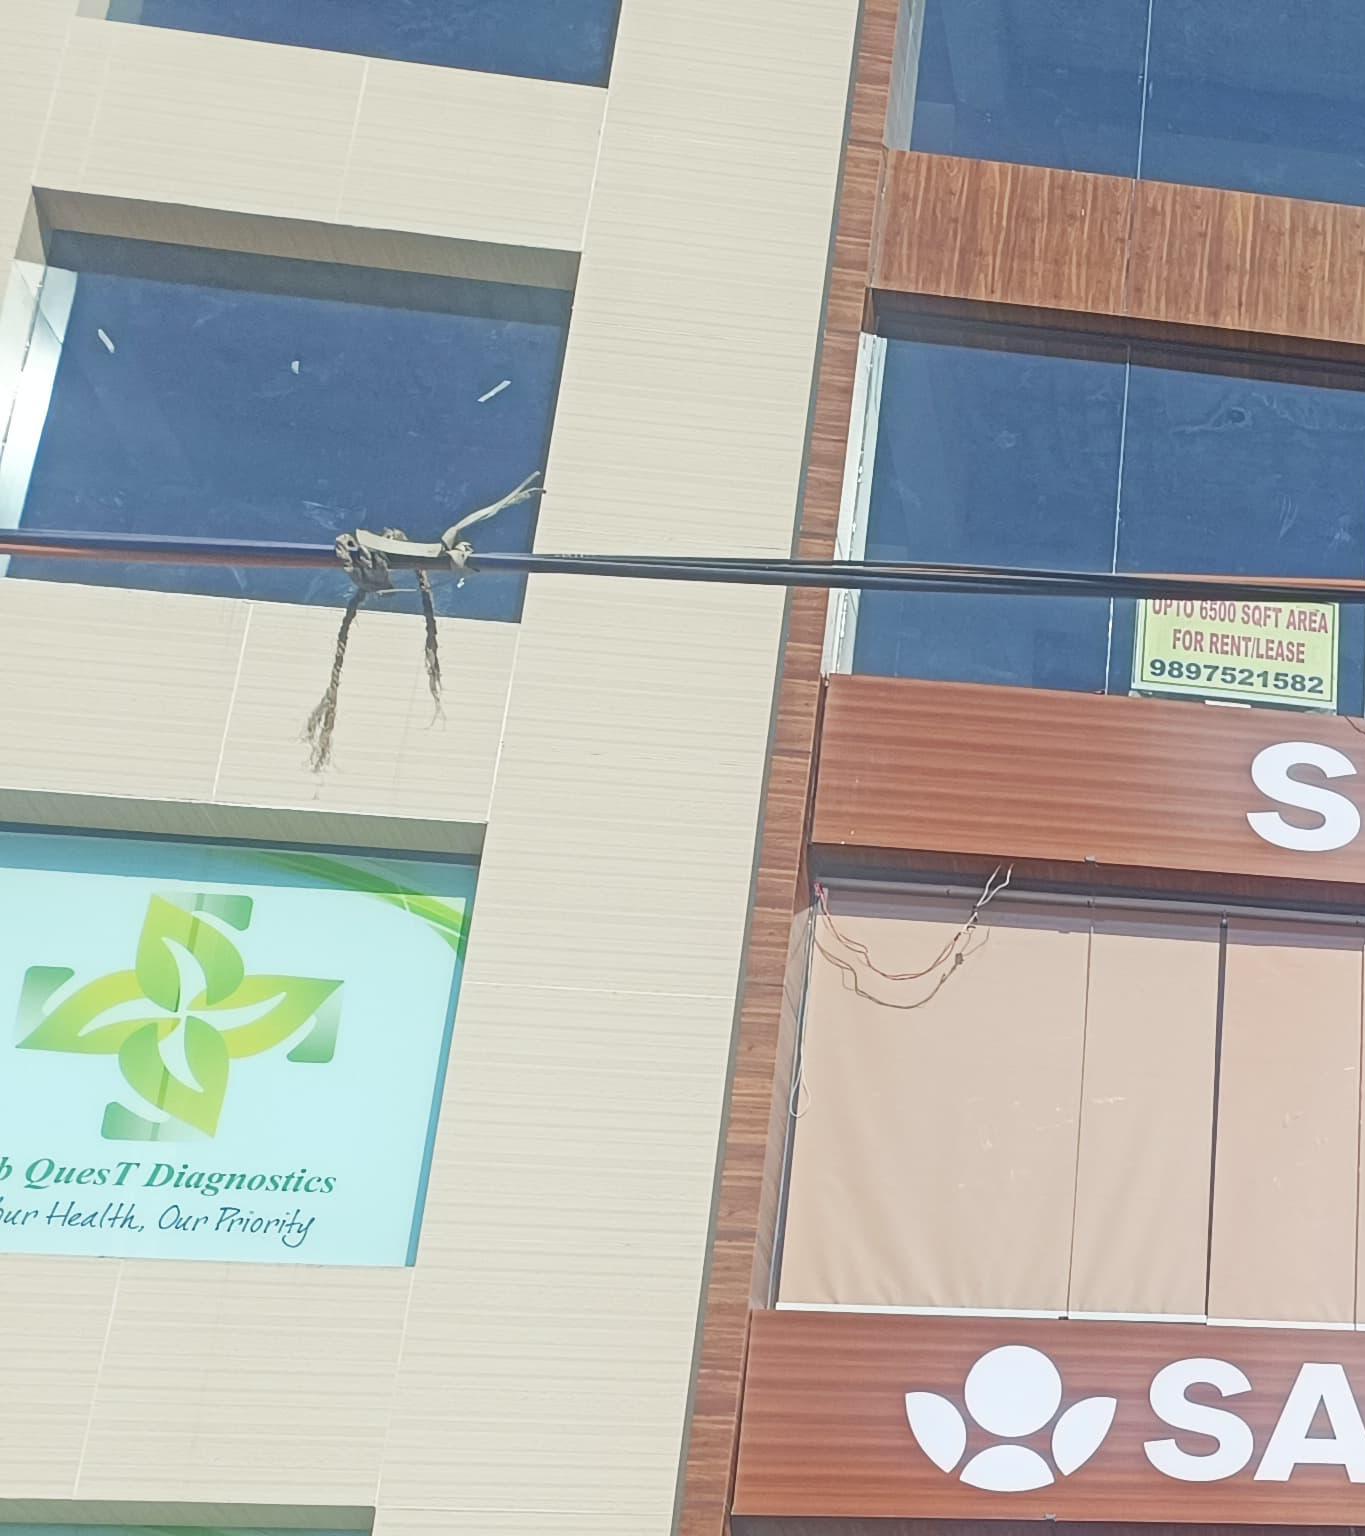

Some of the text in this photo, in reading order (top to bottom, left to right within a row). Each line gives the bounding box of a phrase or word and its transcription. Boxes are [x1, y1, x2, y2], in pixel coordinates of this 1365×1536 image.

[1152, 600, 1328, 633] UPTO 6500 SQFT AREA
[1173, 629, 1305, 663] FOR RENT/LEASE
[1150, 659, 1324, 694] 9897521582
[24, 1158, 140, 1189] QuesT
[141, 1162, 337, 1196] Diagnostics
[46, 1201, 145, 1232] Health,
[158, 1203, 207, 1231] Our
[215, 1206, 316, 1248] Priority
